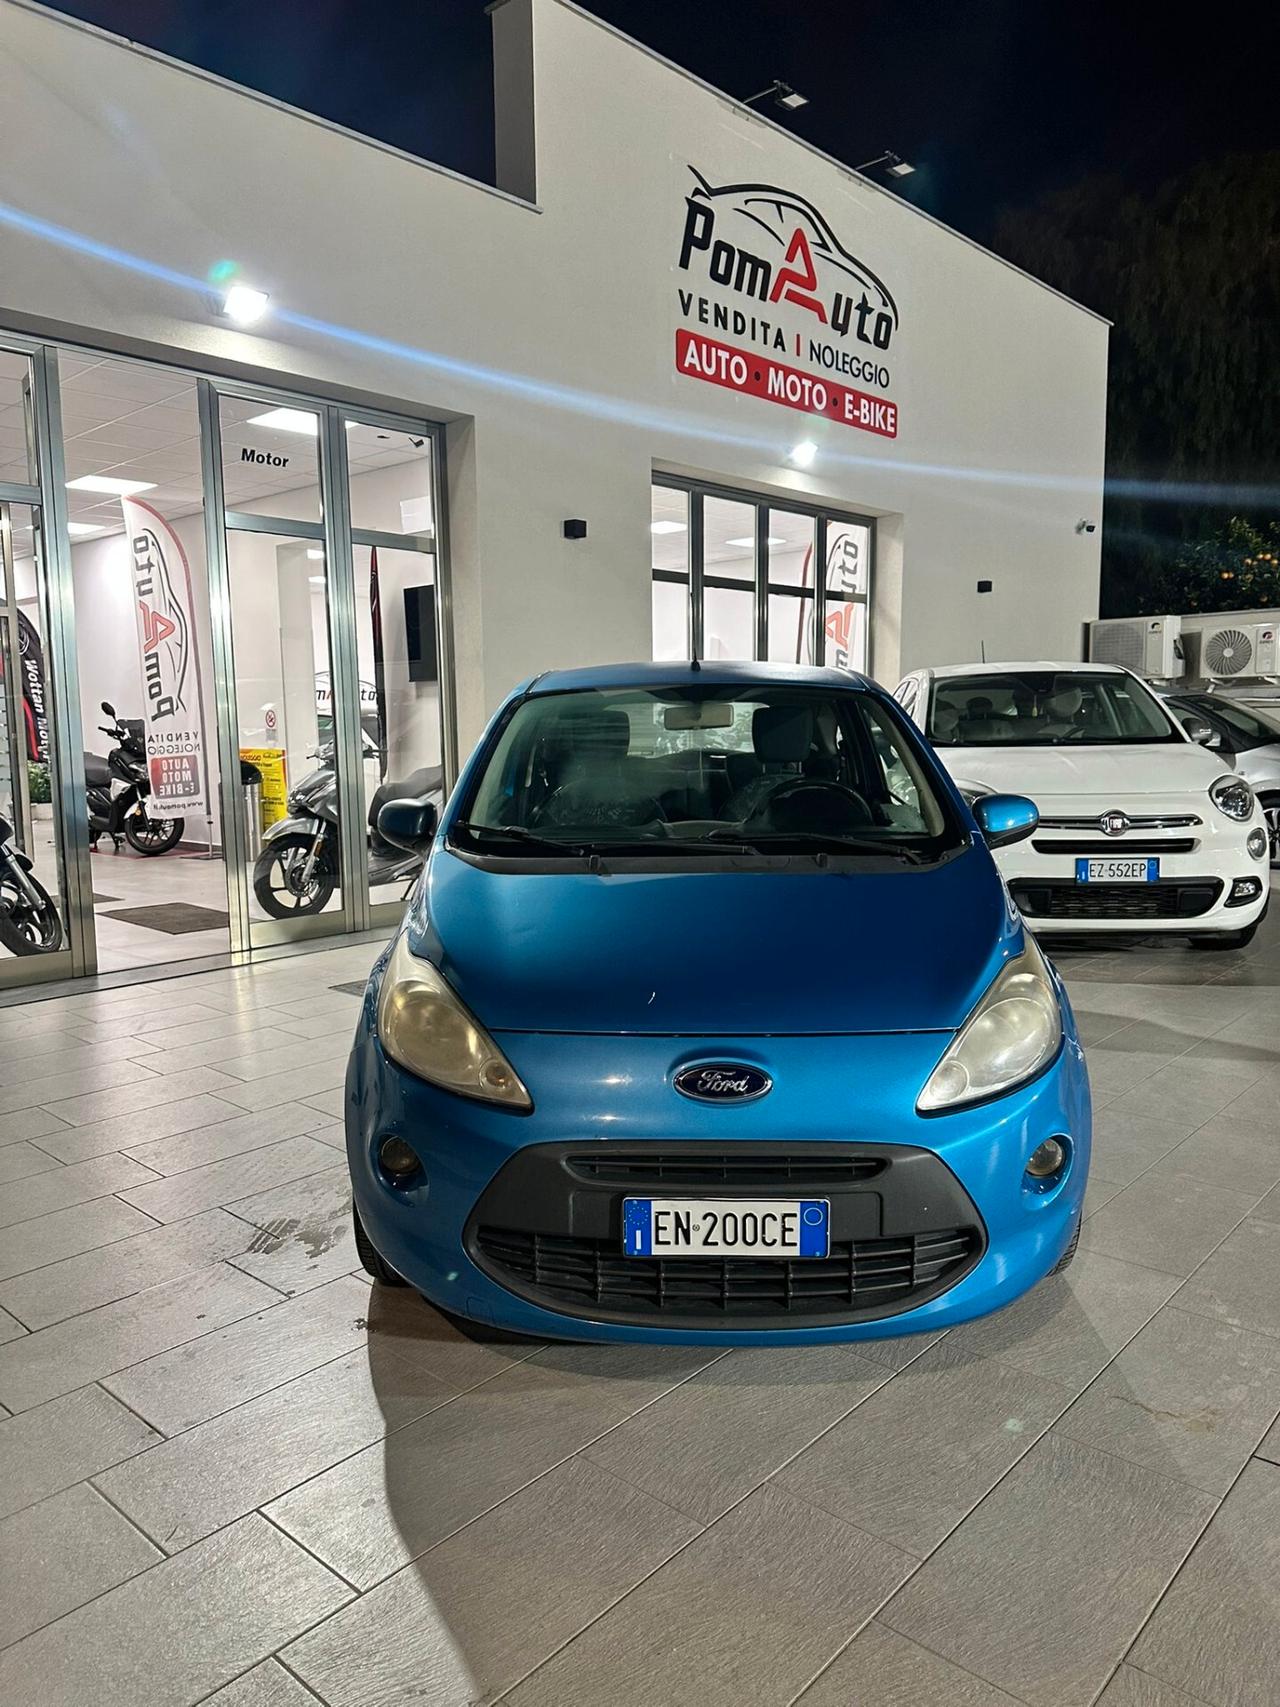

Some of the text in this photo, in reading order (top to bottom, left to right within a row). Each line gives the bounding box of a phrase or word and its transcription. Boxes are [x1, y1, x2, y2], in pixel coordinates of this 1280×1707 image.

[678, 288, 890, 389] VENDITA NOLEGGIO
[684, 339, 896, 433] AUTO MOTO E-BIKE
[241, 448, 289, 468] Motor
[24, 659, 44, 714] Wottan
[1089, 863, 1105, 878] EZ
[1108, 863, 1147, 878] 552EP
[697, 1070, 749, 1093] Ford
[654, 1211, 691, 1246] EN
[702, 1212, 798, 1247] 200CE
